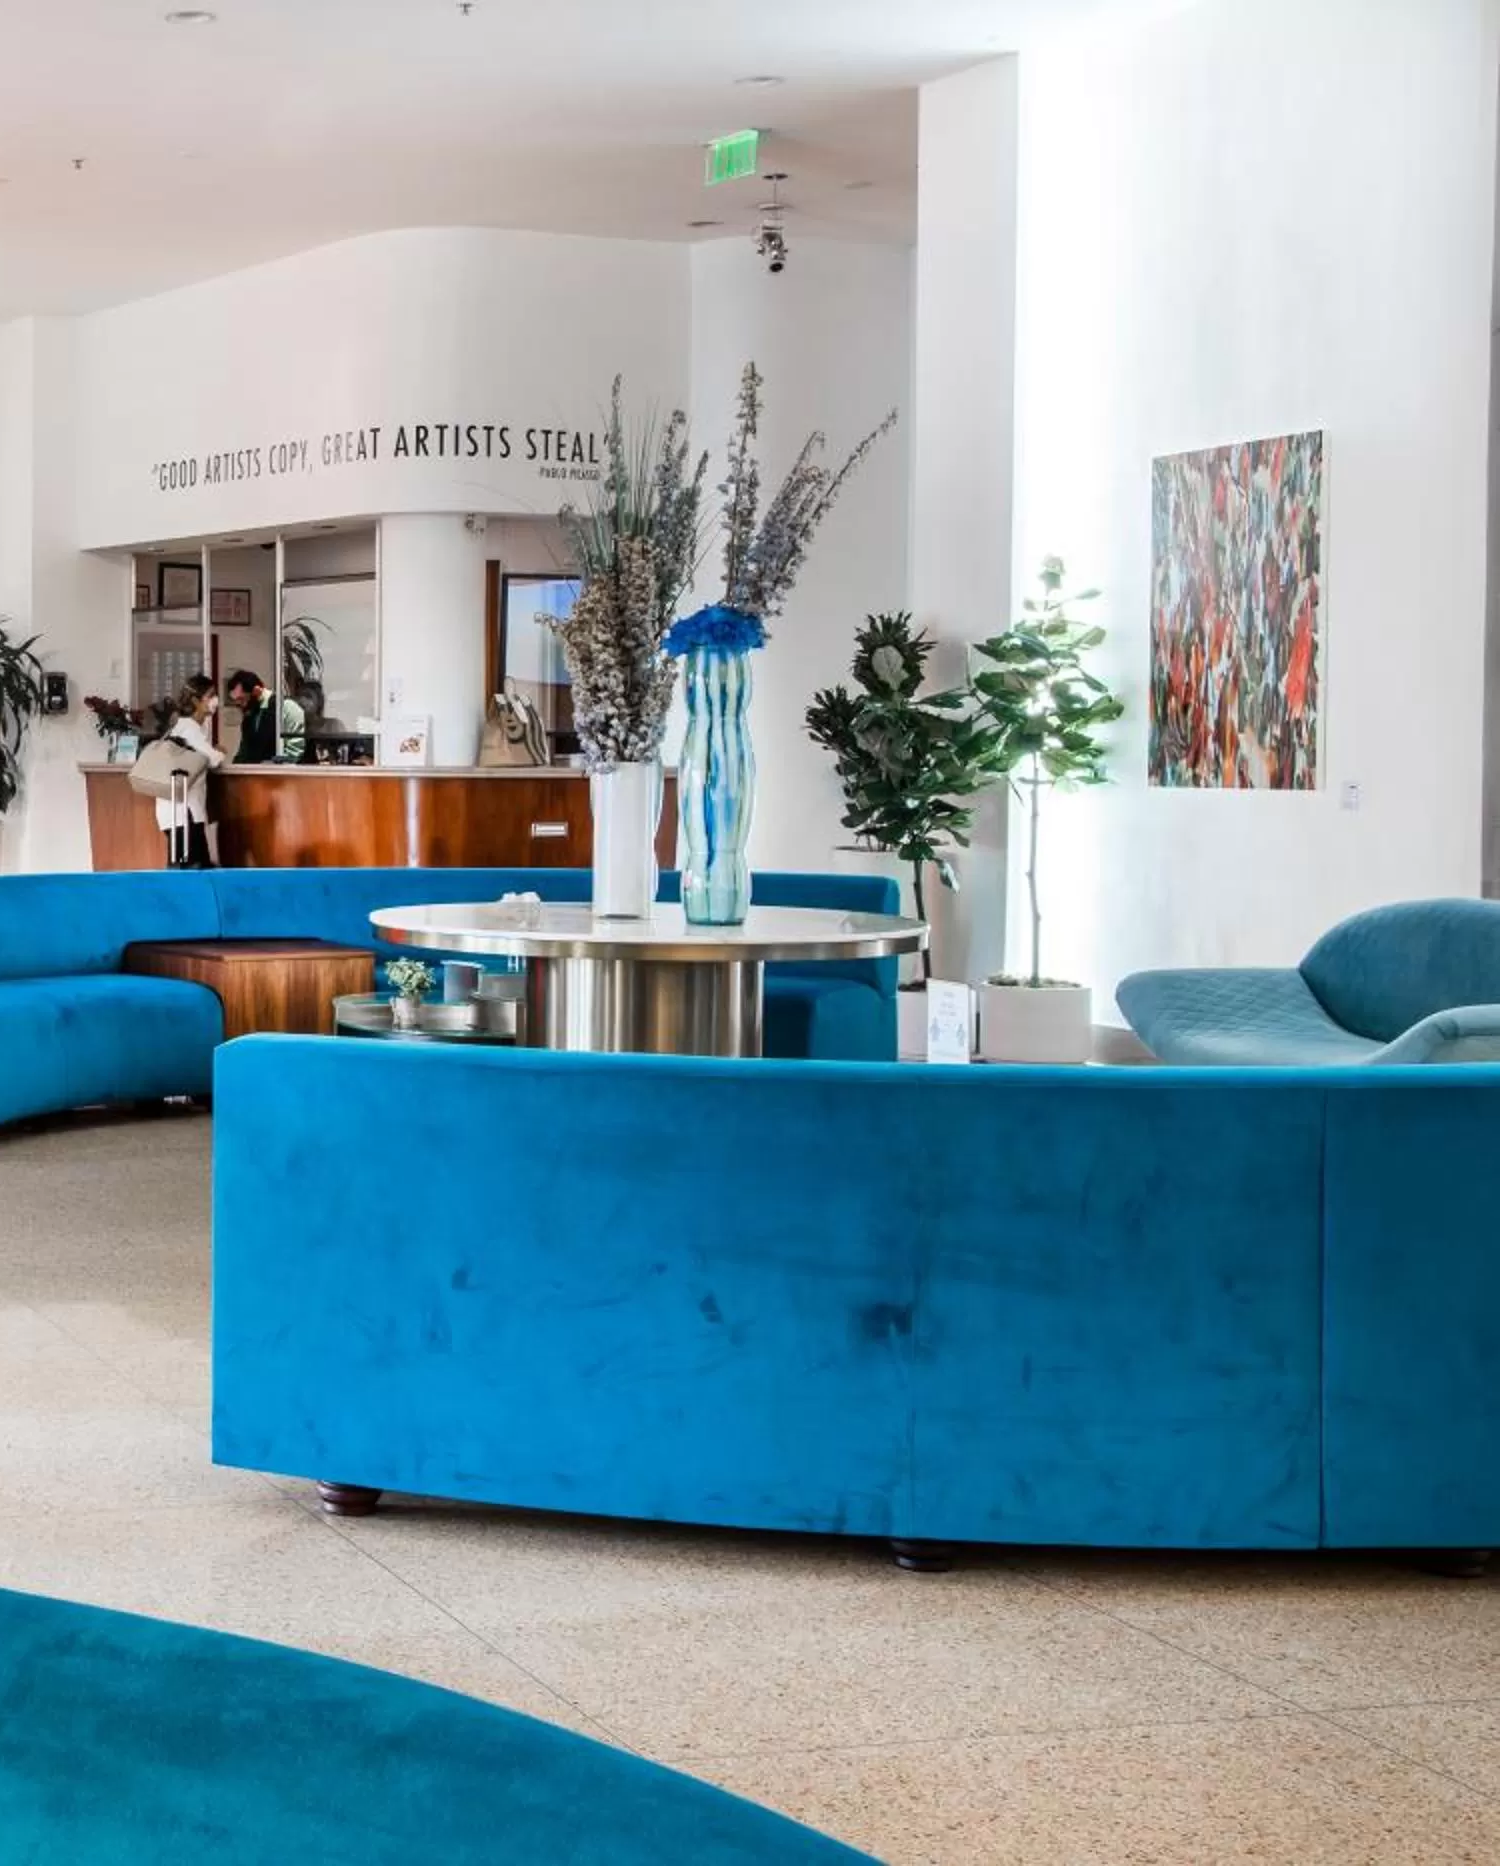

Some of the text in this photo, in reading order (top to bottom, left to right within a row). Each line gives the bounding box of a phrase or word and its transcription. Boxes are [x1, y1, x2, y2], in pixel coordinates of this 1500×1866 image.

[203, 446, 262, 486] ARTISTS
[268, 439, 313, 476] COPY,
[321, 426, 381, 466] GREAT
[392, 423, 511, 459] ARTISTS
